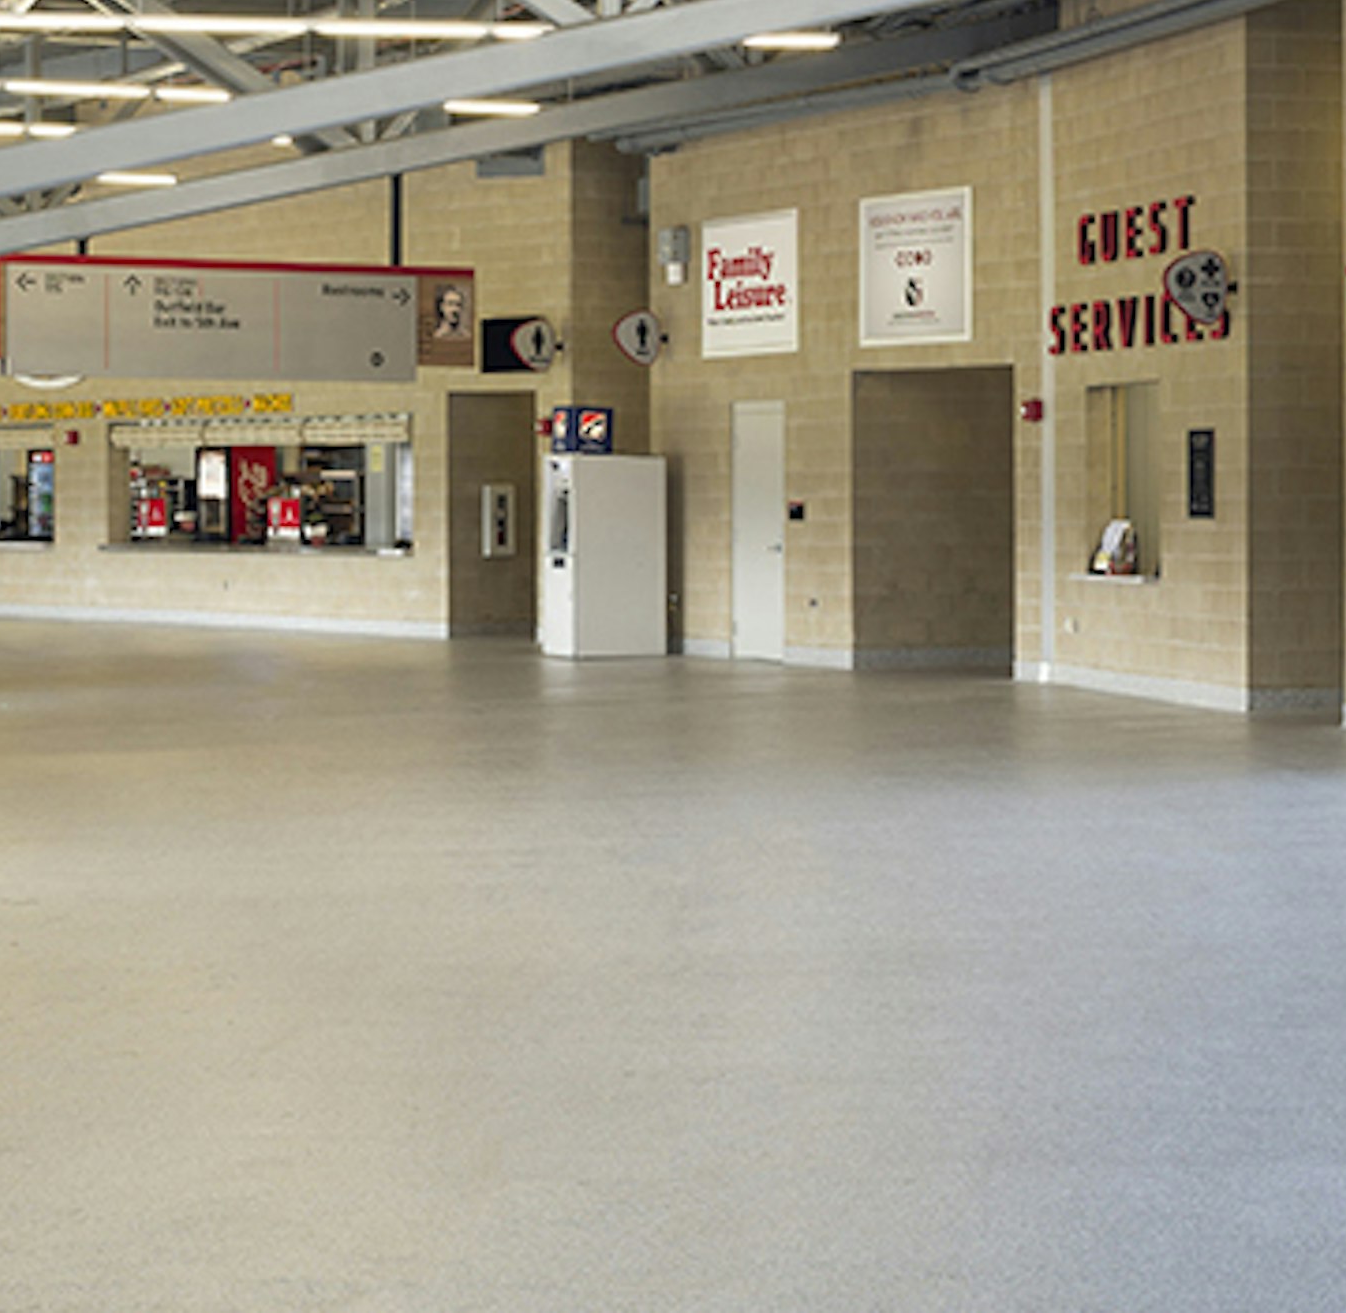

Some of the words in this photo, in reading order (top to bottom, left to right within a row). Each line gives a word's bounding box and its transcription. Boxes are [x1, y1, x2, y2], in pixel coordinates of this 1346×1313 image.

[1077, 195, 1196, 266] GUEST
[707, 247, 775, 281] Family
[714, 280, 785, 311] Leisure
